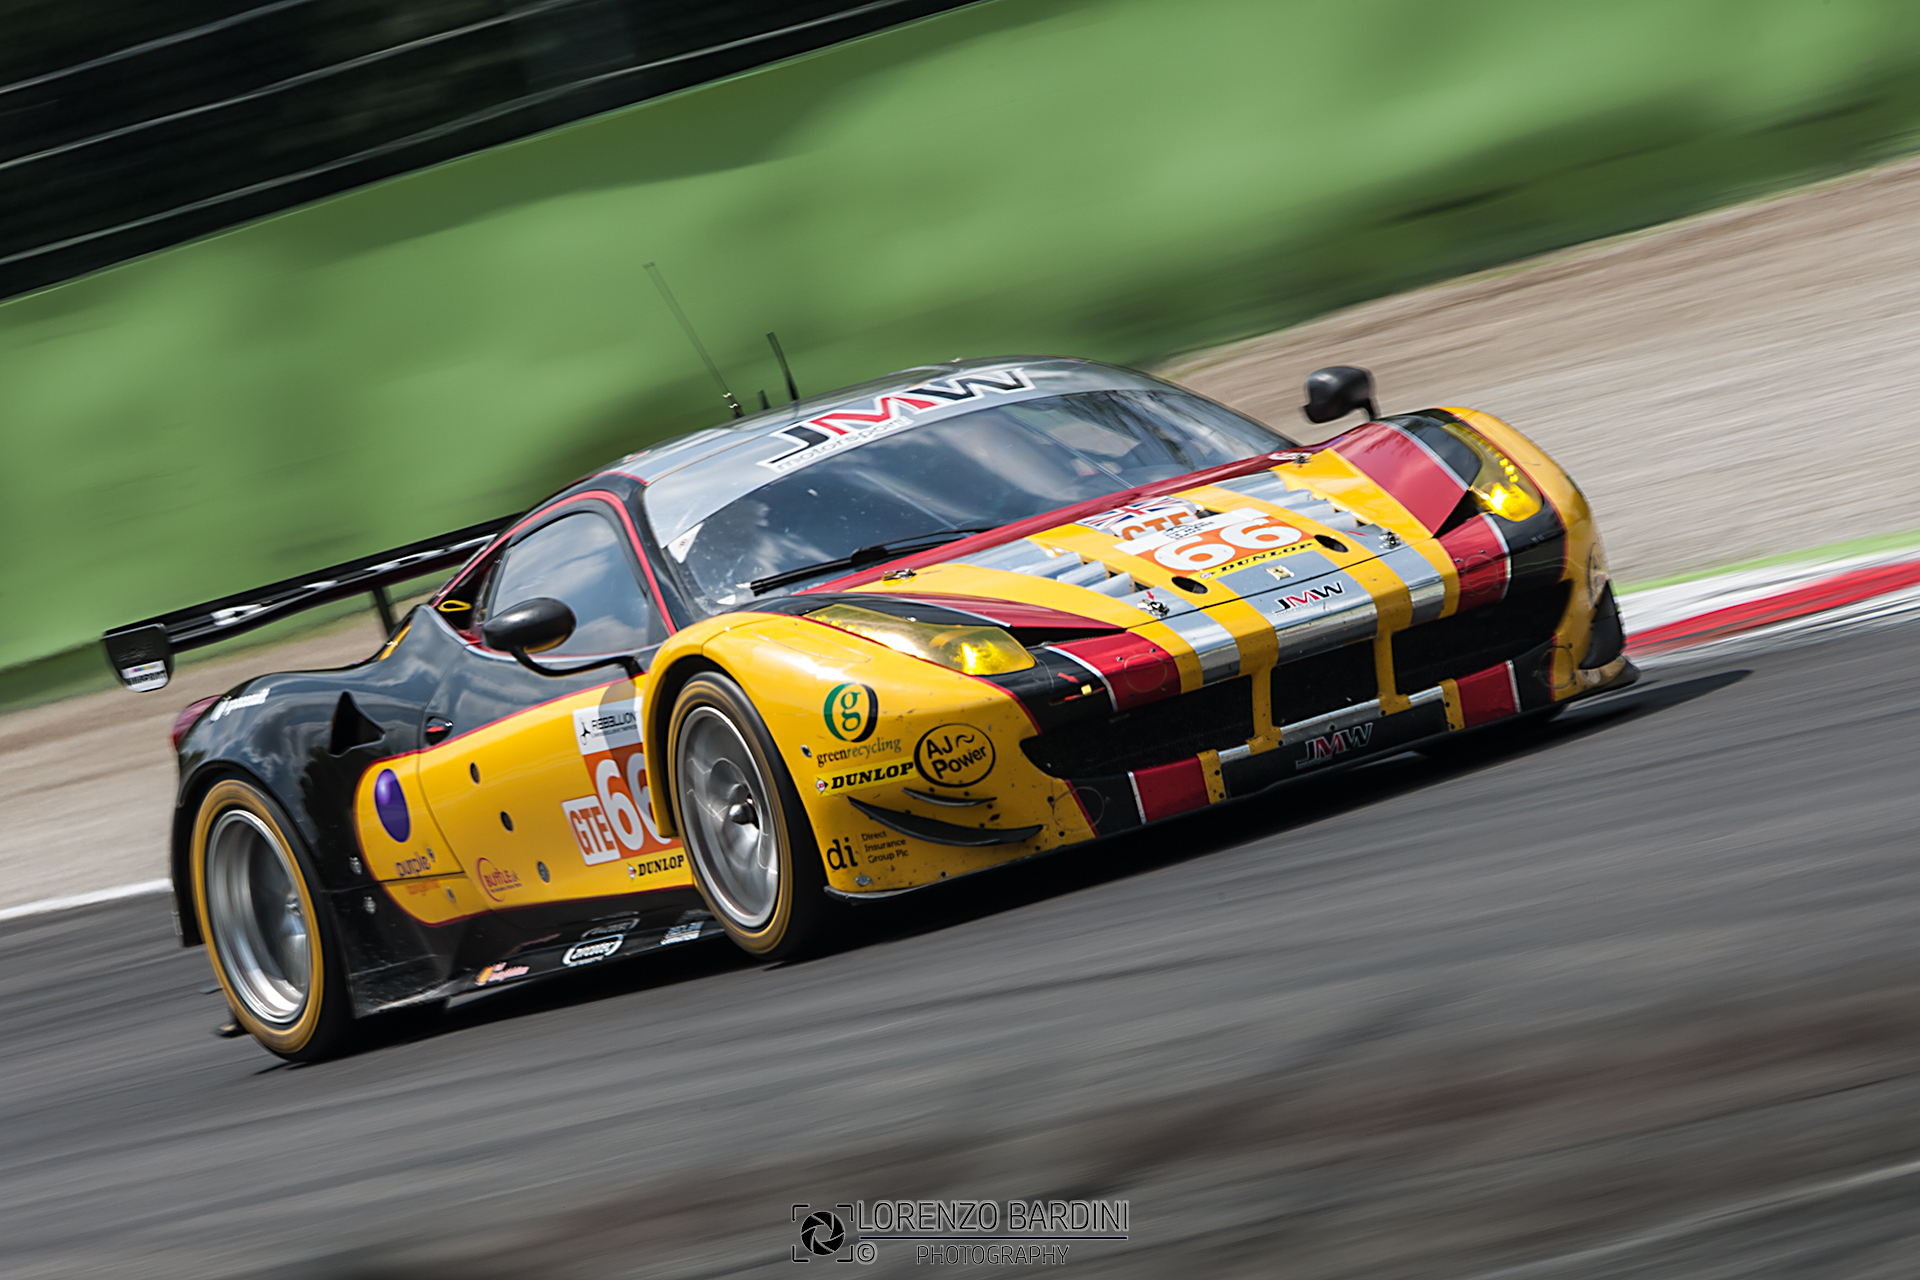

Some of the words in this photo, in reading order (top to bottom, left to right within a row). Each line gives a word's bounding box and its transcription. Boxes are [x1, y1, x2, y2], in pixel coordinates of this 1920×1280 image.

[764, 368, 1036, 467] JMW
[777, 416, 908, 471] motorsport
[1154, 517, 1302, 571] 66
[1219, 543, 1313, 572] DUNLOP
[1274, 581, 1343, 613] JMW
[926, 735, 953, 759] AJ
[1296, 722, 1374, 769] JMW
[831, 762, 914, 789] DUNLOP
[932, 745, 987, 779] Power
[569, 806, 616, 856] GTE
[861, 831, 887, 842] Direct
[864, 839, 906, 853] Insurance
[638, 855, 684, 876] DUNLOP
[826, 837, 858, 870] di
[867, 852, 895, 864] Group
